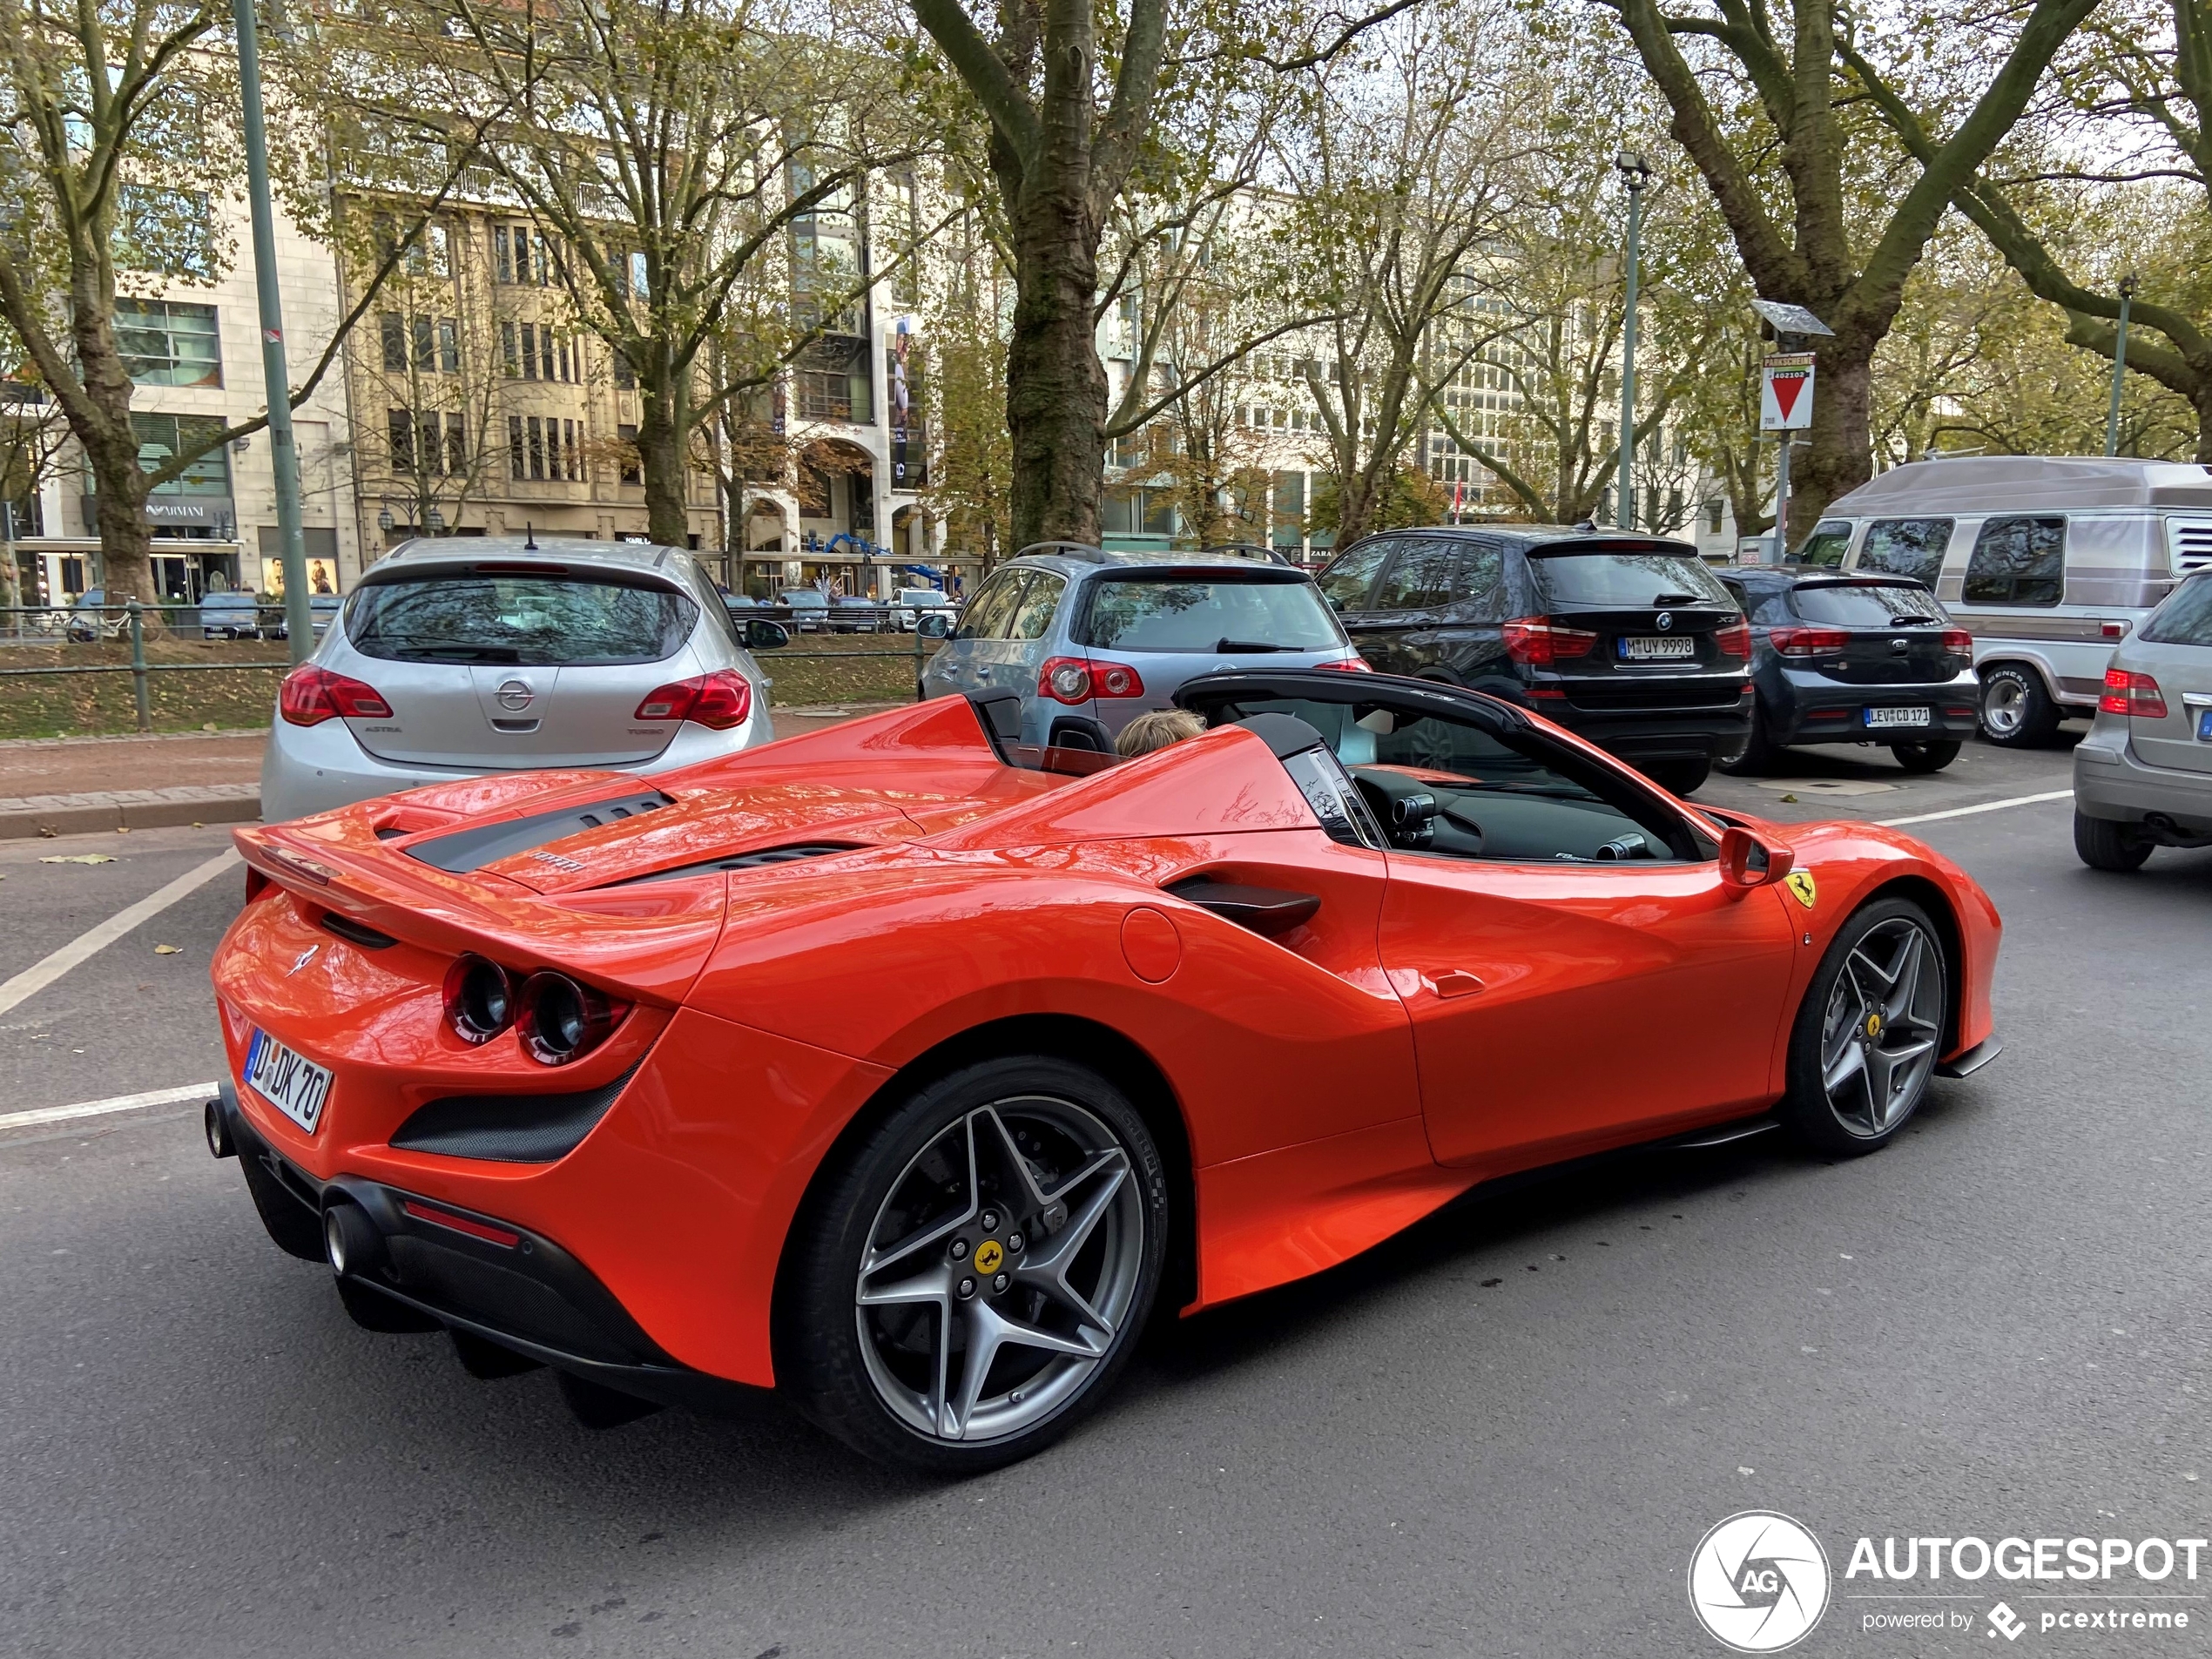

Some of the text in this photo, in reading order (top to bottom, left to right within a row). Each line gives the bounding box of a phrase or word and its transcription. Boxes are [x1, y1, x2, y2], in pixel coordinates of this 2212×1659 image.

[1764, 356, 1814, 367] PARKSCHEINE
[164, 505, 204, 517] ARMANI
[1627, 639, 1635, 654] M
[1662, 638, 1692, 653] 9998
[1987, 670, 2031, 698] GENERAL
[1871, 708, 1930, 723] LEV CD 171
[253, 1034, 325, 1121] D DK 70
